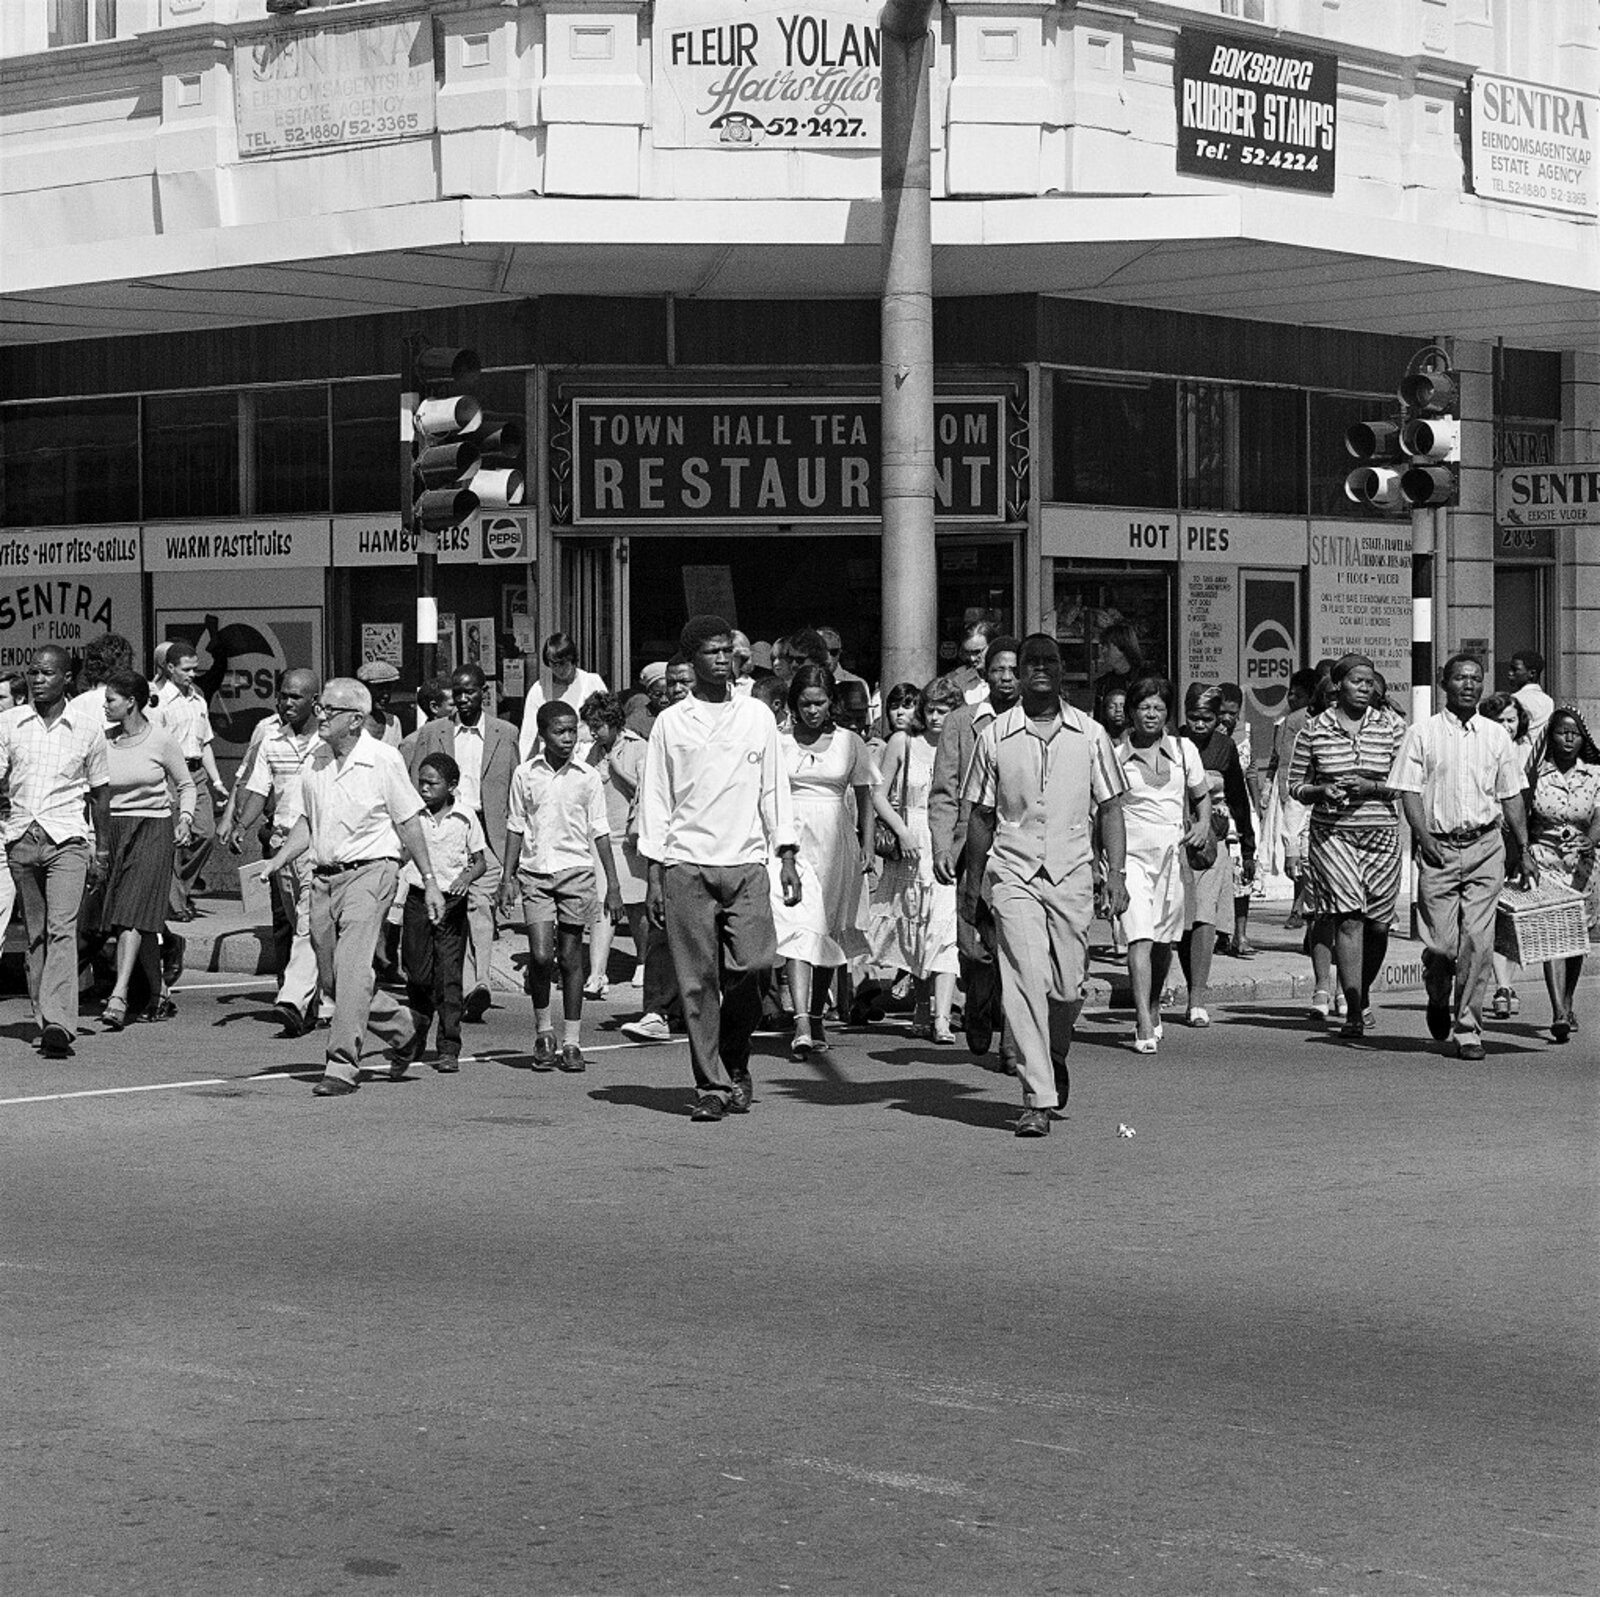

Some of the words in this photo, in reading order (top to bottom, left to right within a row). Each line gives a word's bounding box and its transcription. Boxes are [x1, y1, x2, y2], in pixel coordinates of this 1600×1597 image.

[671, 23, 758, 66] FLEUR
[1209, 45, 1314, 91] BOKSBURG
[696, 66, 881, 116] Hairstylis
[275, 103, 331, 127] ESTATE
[339, 95, 404, 120] AGENCY
[1182, 78, 1257, 138] RUBBER
[1263, 93, 1334, 150] STAMPS
[1483, 82, 1590, 140] SENTRA
[1481, 130, 1592, 166] EIENDOMSAGENTSKAP
[1491, 155, 1529, 176] ESTATE
[1537, 162, 1582, 184] AGENCY
[589, 415, 685, 446] TOWN
[713, 415, 792, 446] HALL
[810, 414, 867, 446] TEA
[938, 413, 988, 445] OM
[594, 456, 991, 509] RESTAURNT
[1528, 511, 1556, 522] EERSTE
[1560, 509, 1588, 521] VLOER
[166, 535, 209, 560] WARM
[359, 525, 470, 554] HAMBUERS
[489, 532, 521, 546] PEPSI
[1129, 523, 1170, 549] HOT
[1187, 526, 1229, 551] PIES
[1311, 535, 1361, 567] SENTRA
[1502, 530, 1536, 549] 284
[39, 542, 63, 565] HOT
[0, 581, 112, 632] SENTRA
[49, 621, 81, 640] FLOOR
[1247, 658, 1293, 679] PEPSI
